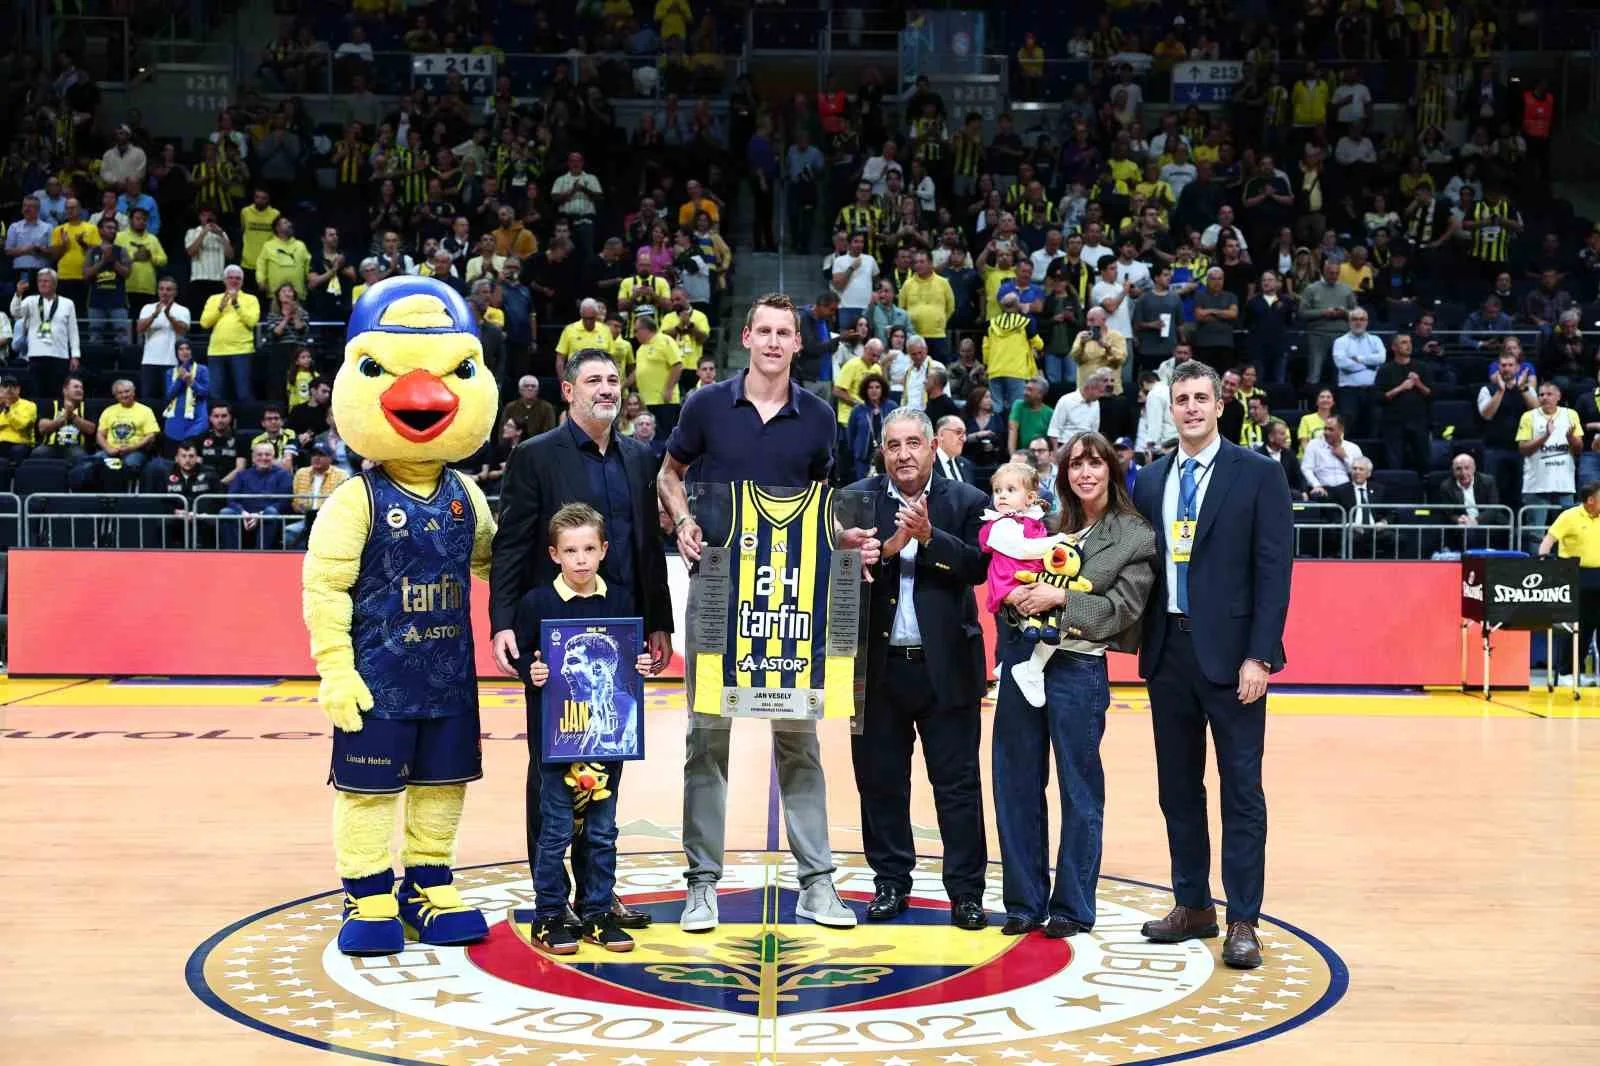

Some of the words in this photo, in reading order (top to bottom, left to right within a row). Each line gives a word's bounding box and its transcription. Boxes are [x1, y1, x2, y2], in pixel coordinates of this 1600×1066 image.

[445, 57, 485, 73] 214
[1210, 66, 1239, 80] 213
[756, 565, 799, 597] 24
[1495, 584, 1571, 603] SPALDING
[401, 575, 461, 613] tarfin
[740, 601, 810, 639] tarfin
[760, 657, 803, 671] ASTOR
[560, 700, 588, 733] JAN
